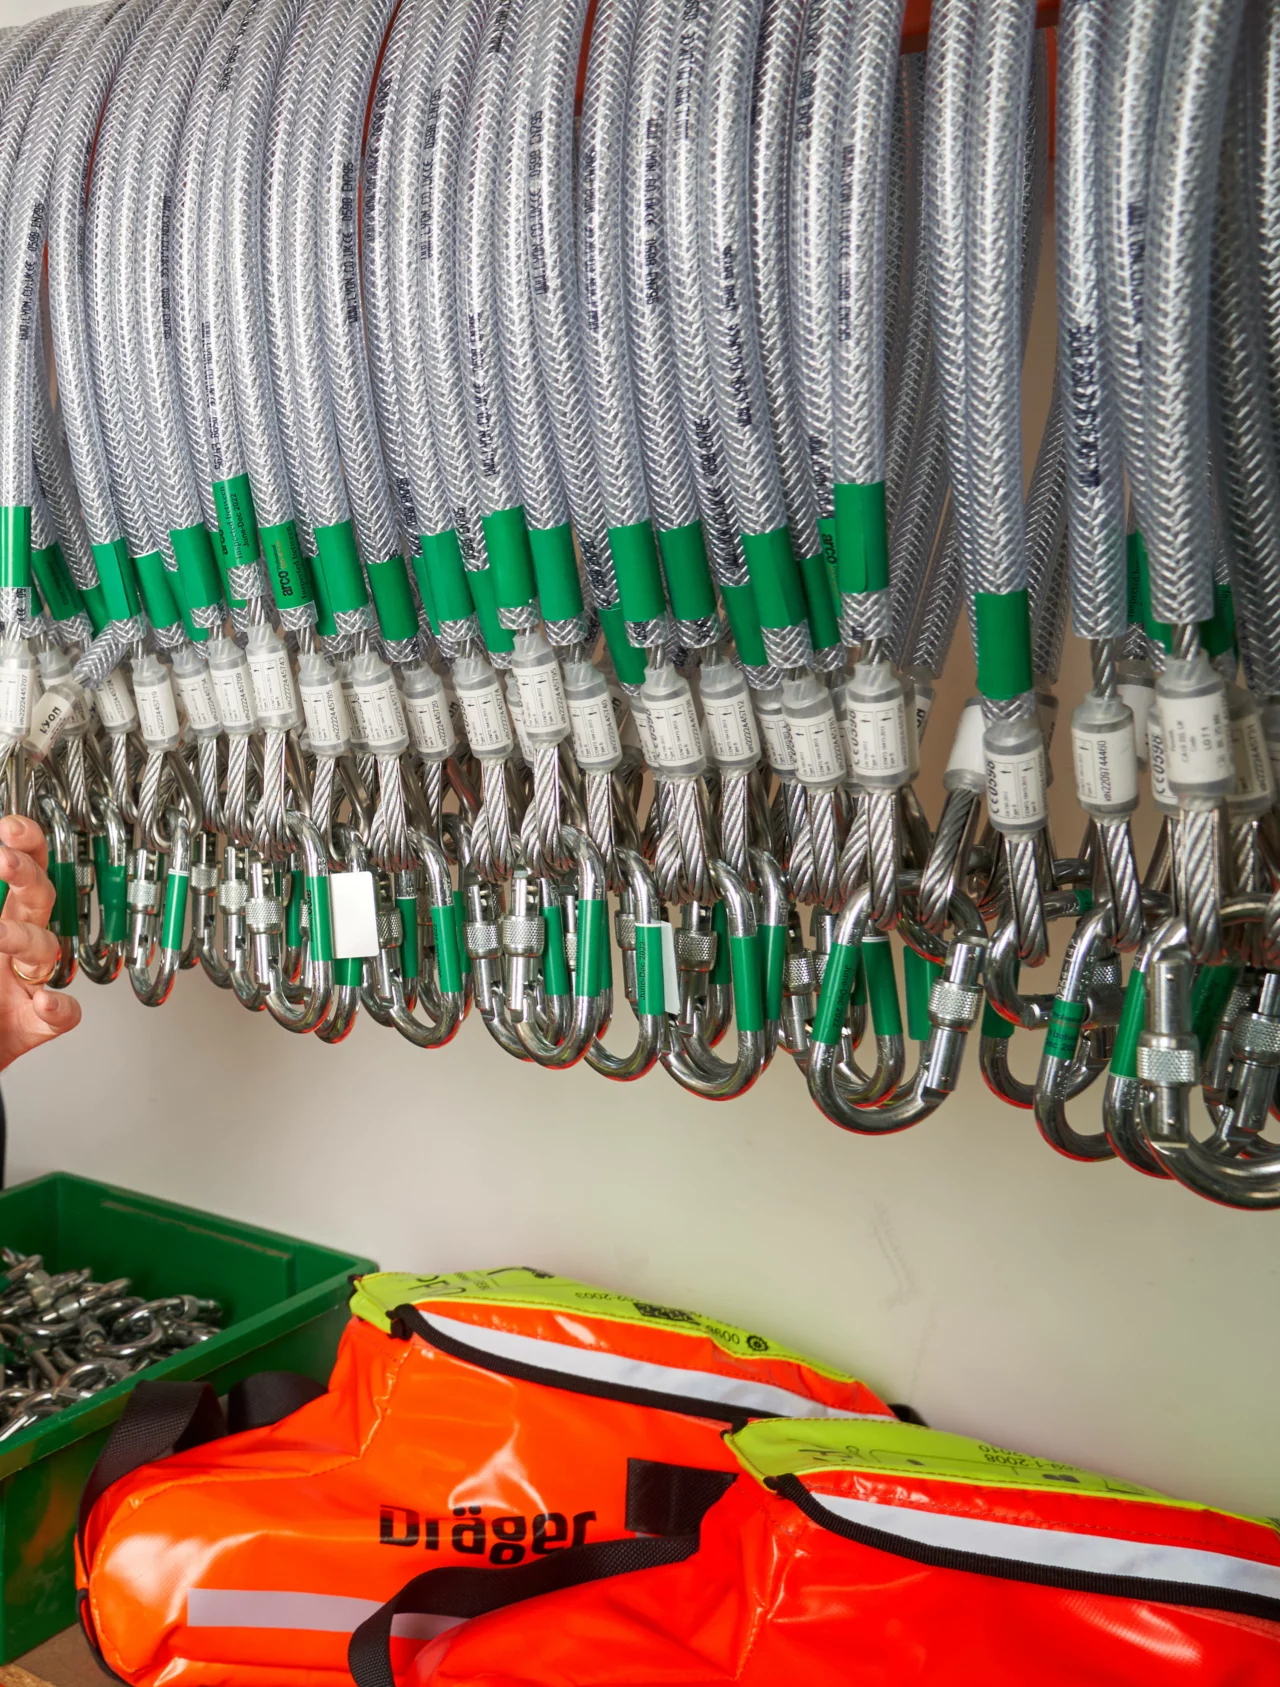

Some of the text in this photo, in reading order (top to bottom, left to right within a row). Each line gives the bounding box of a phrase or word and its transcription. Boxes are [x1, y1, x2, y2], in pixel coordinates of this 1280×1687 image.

[428, 89, 441, 120] EN795
[423, 124, 436, 150] 0598
[529, 110, 542, 145] EN795
[343, 162, 353, 192] EN795
[529, 150, 541, 177] 0598
[30, 202, 44, 228] EN795
[342, 198, 352, 222] 0598
[28, 232, 39, 252] 0598
[162, 288, 171, 309] 0598
[163, 313, 172, 340] EN795
[695, 418, 713, 449] EN795
[700, 453, 718, 476] 0598
[396, 478, 413, 503] EN795
[219, 487, 243, 559] Inspected between
[231, 493, 249, 547] June-Dec 2022
[403, 507, 418, 526] 0598
[453, 508, 470, 534] EN795
[286, 526, 308, 599] Inspected between
[822, 534, 837, 564] arco
[278, 571, 293, 596] arco
[833, 965, 854, 1028] June-Dec 2022
[378, 1502, 597, 1566] Dräger
